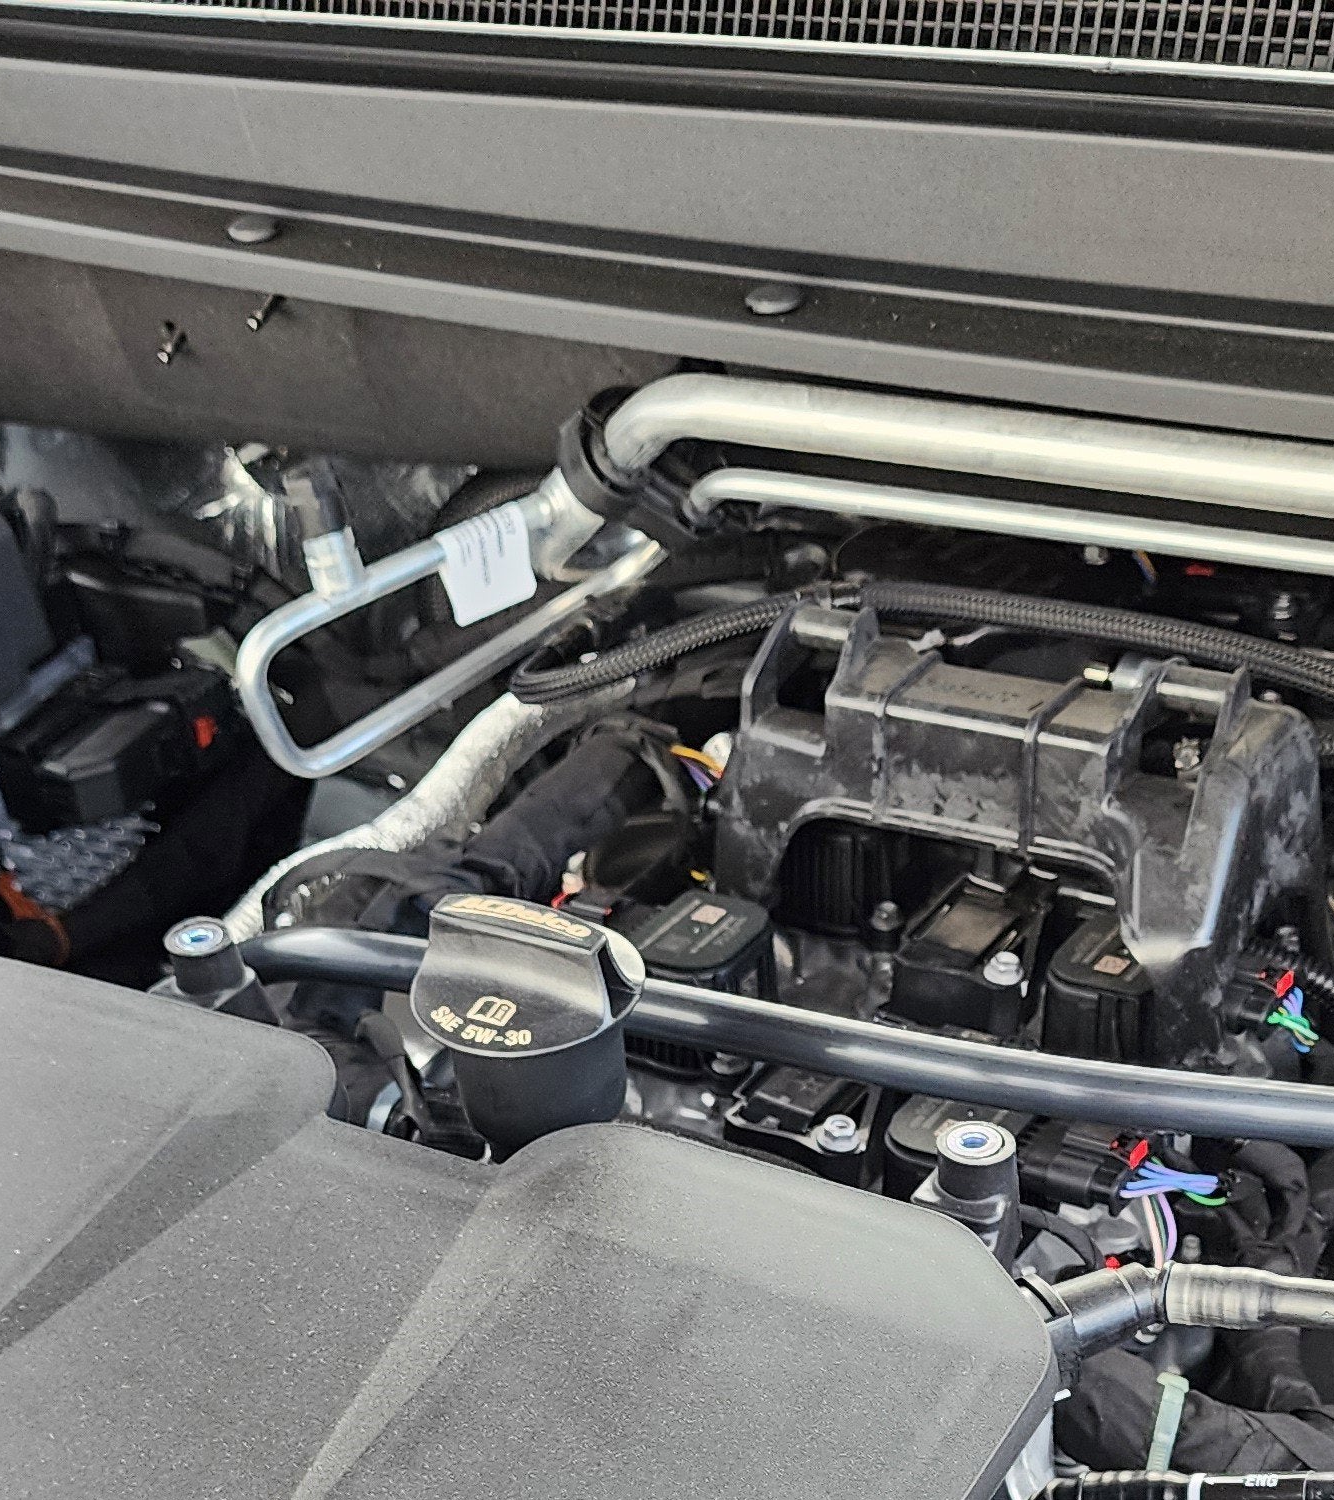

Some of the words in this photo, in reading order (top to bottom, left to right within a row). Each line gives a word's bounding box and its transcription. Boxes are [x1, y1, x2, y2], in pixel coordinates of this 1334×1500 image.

[430, 1005, 464, 1034] SAE
[460, 1024, 533, 1048] 5W-30
[1244, 1472, 1278, 1487] ENG
